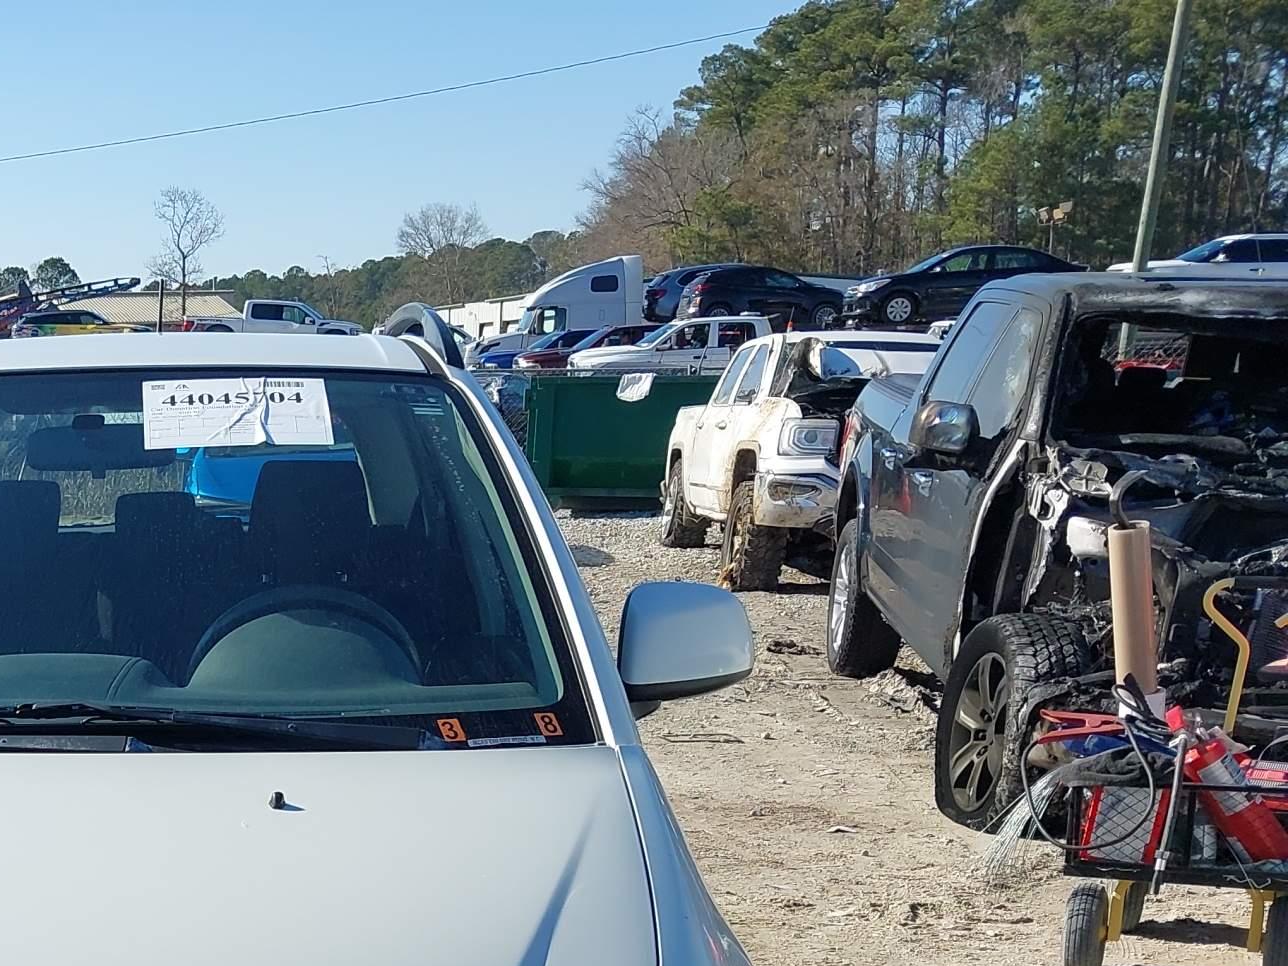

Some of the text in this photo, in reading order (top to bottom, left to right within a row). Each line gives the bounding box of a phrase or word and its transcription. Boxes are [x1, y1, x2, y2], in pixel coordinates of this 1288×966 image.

[161, 391, 304, 406] 44045704
[441, 721, 460, 740] 3
[540, 714, 558, 734] 8
